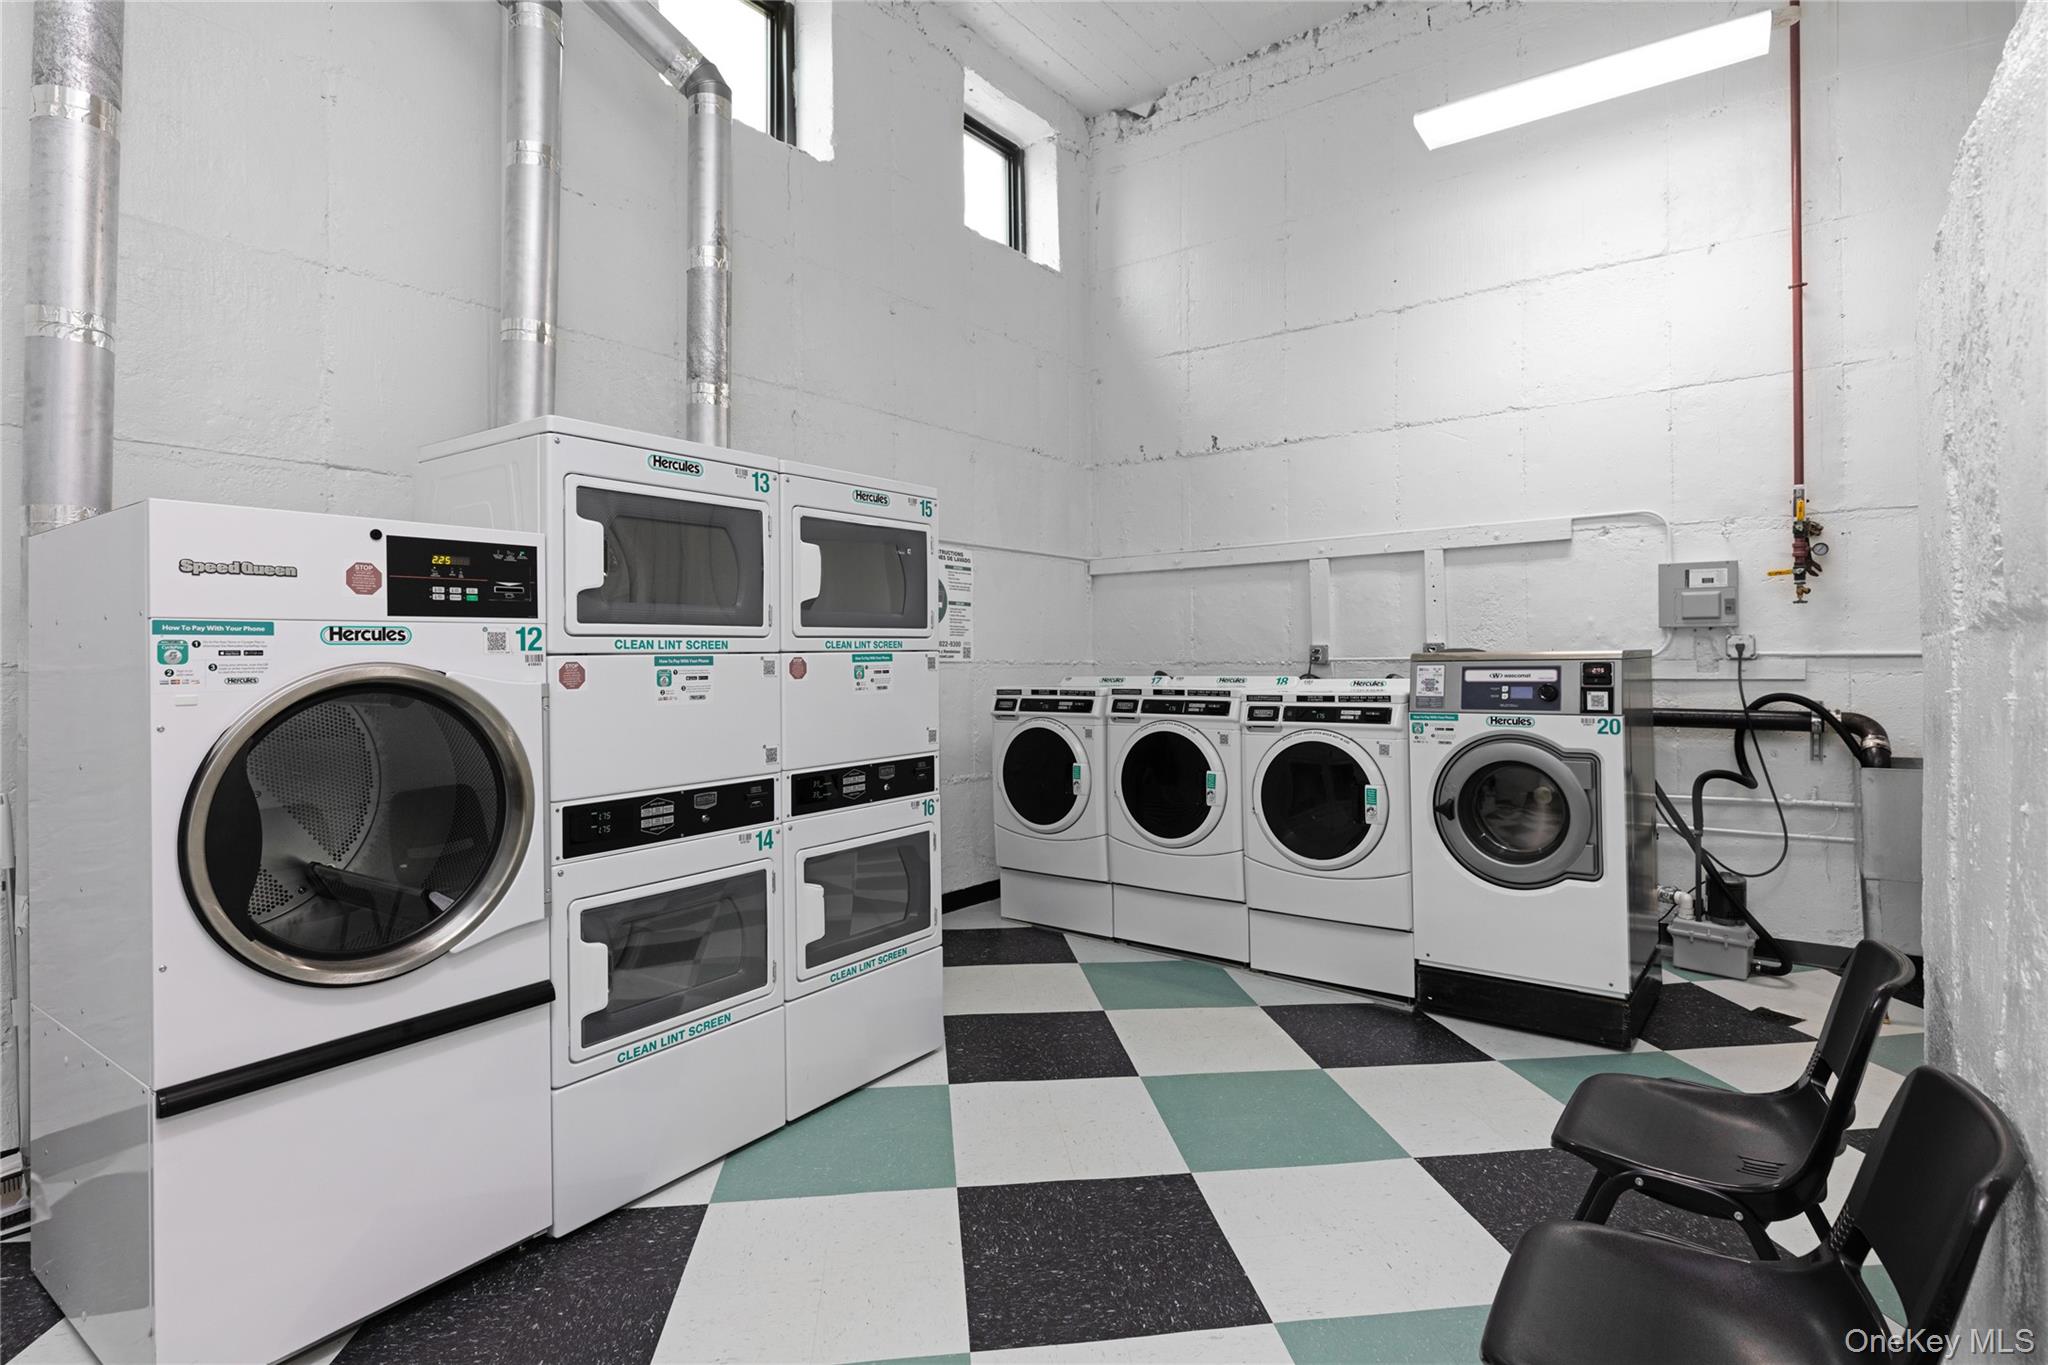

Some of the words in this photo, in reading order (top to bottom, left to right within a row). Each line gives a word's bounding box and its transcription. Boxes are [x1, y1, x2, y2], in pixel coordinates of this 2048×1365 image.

[652, 456, 700, 474] Hercules
[752, 473, 770, 493] 13
[855, 490, 888, 505] Hercules
[920, 499, 932, 518] 15
[180, 558, 241, 576] Speed
[241, 562, 298, 578] Queen
[328, 626, 406, 643] Hercules
[516, 627, 542, 651] 12
[614, 640, 655, 650] CLEAN
[659, 640, 683, 649] LINT
[686, 640, 728, 649] SCREEN
[825, 640, 852, 649] CLEAN
[855, 640, 872, 649] LINT
[873, 640, 903, 649] SCREEN
[1276, 677, 1288, 685] 18
[1490, 717, 1532, 726] Hercules
[1597, 718, 1621, 735] 20
[922, 799, 934, 816] 16
[756, 829, 774, 851] 14
[830, 968, 857, 983] CLEAN
[858, 962, 876, 974] LINT
[878, 948, 908, 968] SCREEN
[617, 1040, 656, 1063] CLEAN
[660, 1030, 685, 1048] LINT
[688, 1013, 732, 1038] SCREEN
